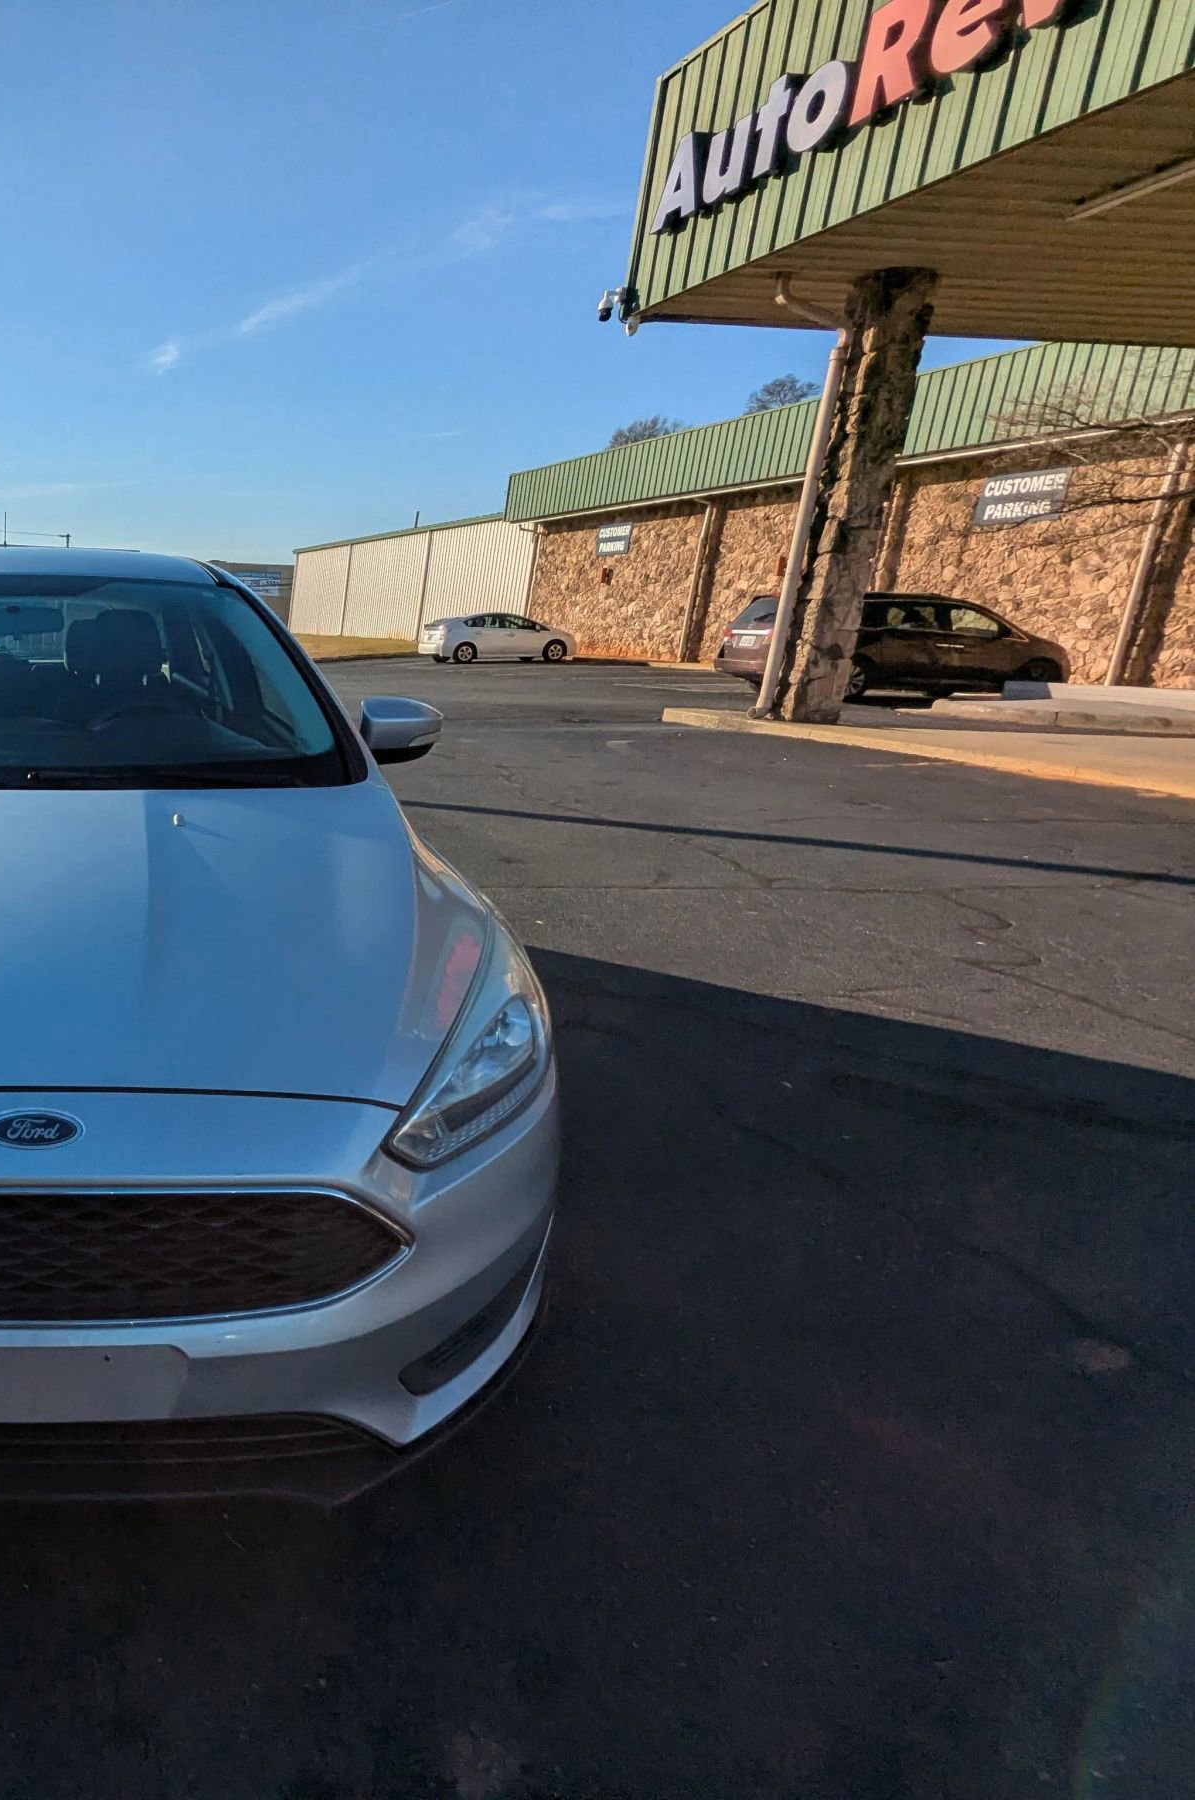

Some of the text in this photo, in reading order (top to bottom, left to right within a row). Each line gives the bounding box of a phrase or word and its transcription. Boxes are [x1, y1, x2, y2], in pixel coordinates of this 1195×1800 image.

[984, 473, 1066, 497] CUSTOMER
[983, 500, 1051, 520] PARKING
[599, 525, 631, 538] CUSTOMER
[599, 540, 625, 552] PARKING
[7, 1119, 61, 1139] Ford
